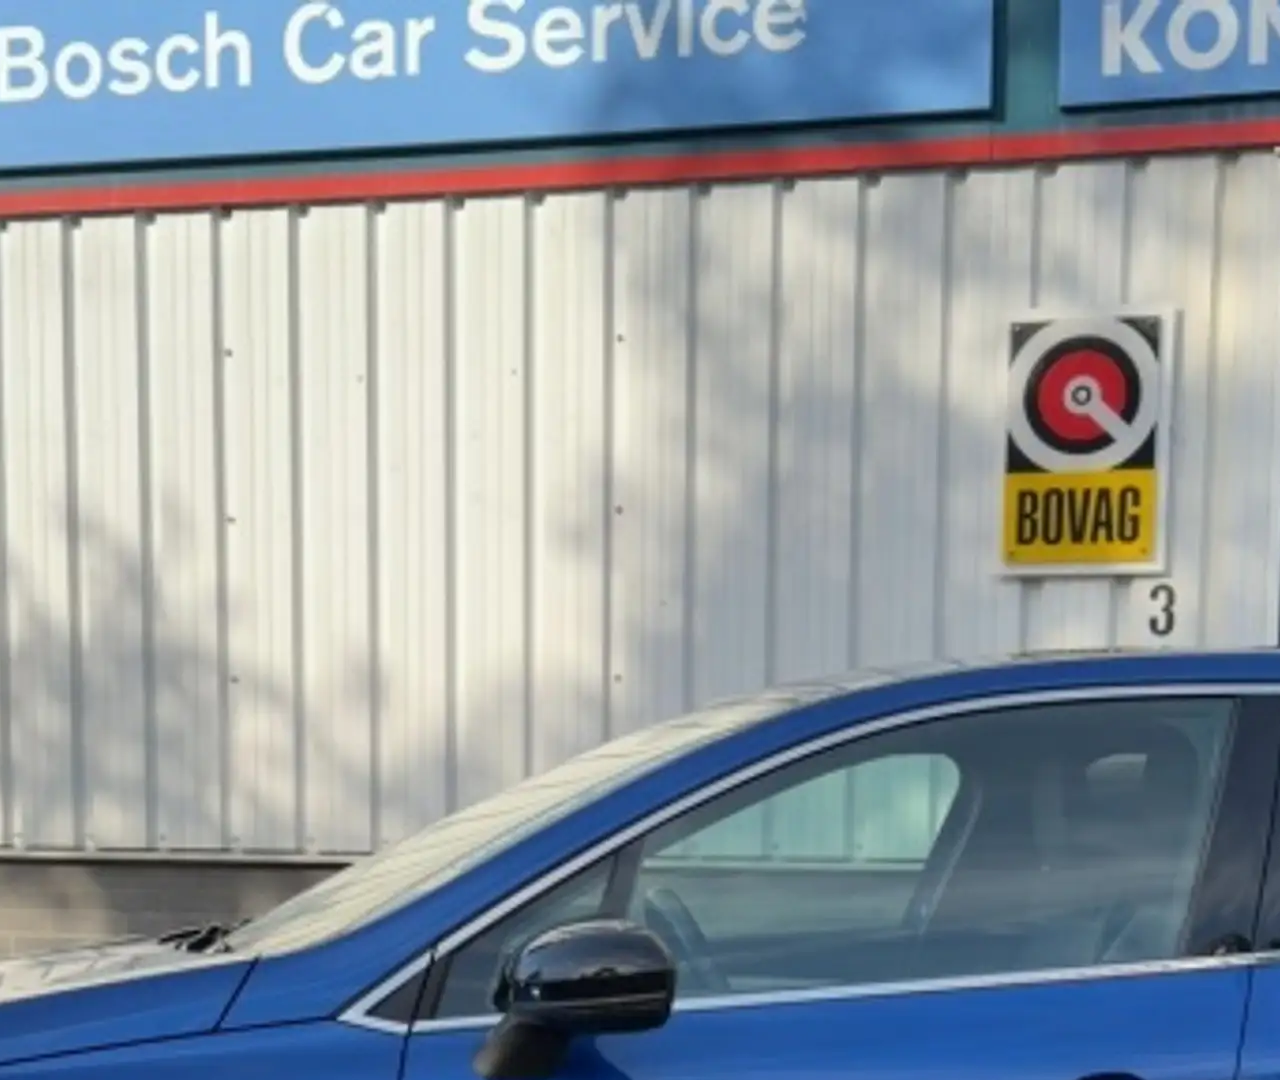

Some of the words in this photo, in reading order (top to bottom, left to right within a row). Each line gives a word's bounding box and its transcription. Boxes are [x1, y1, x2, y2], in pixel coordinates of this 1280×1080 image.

[283, 1, 436, 84] Car
[464, 0, 807, 73] Service
[1016, 486, 1140, 546] BOVAG
[1148, 584, 1176, 637] 3
